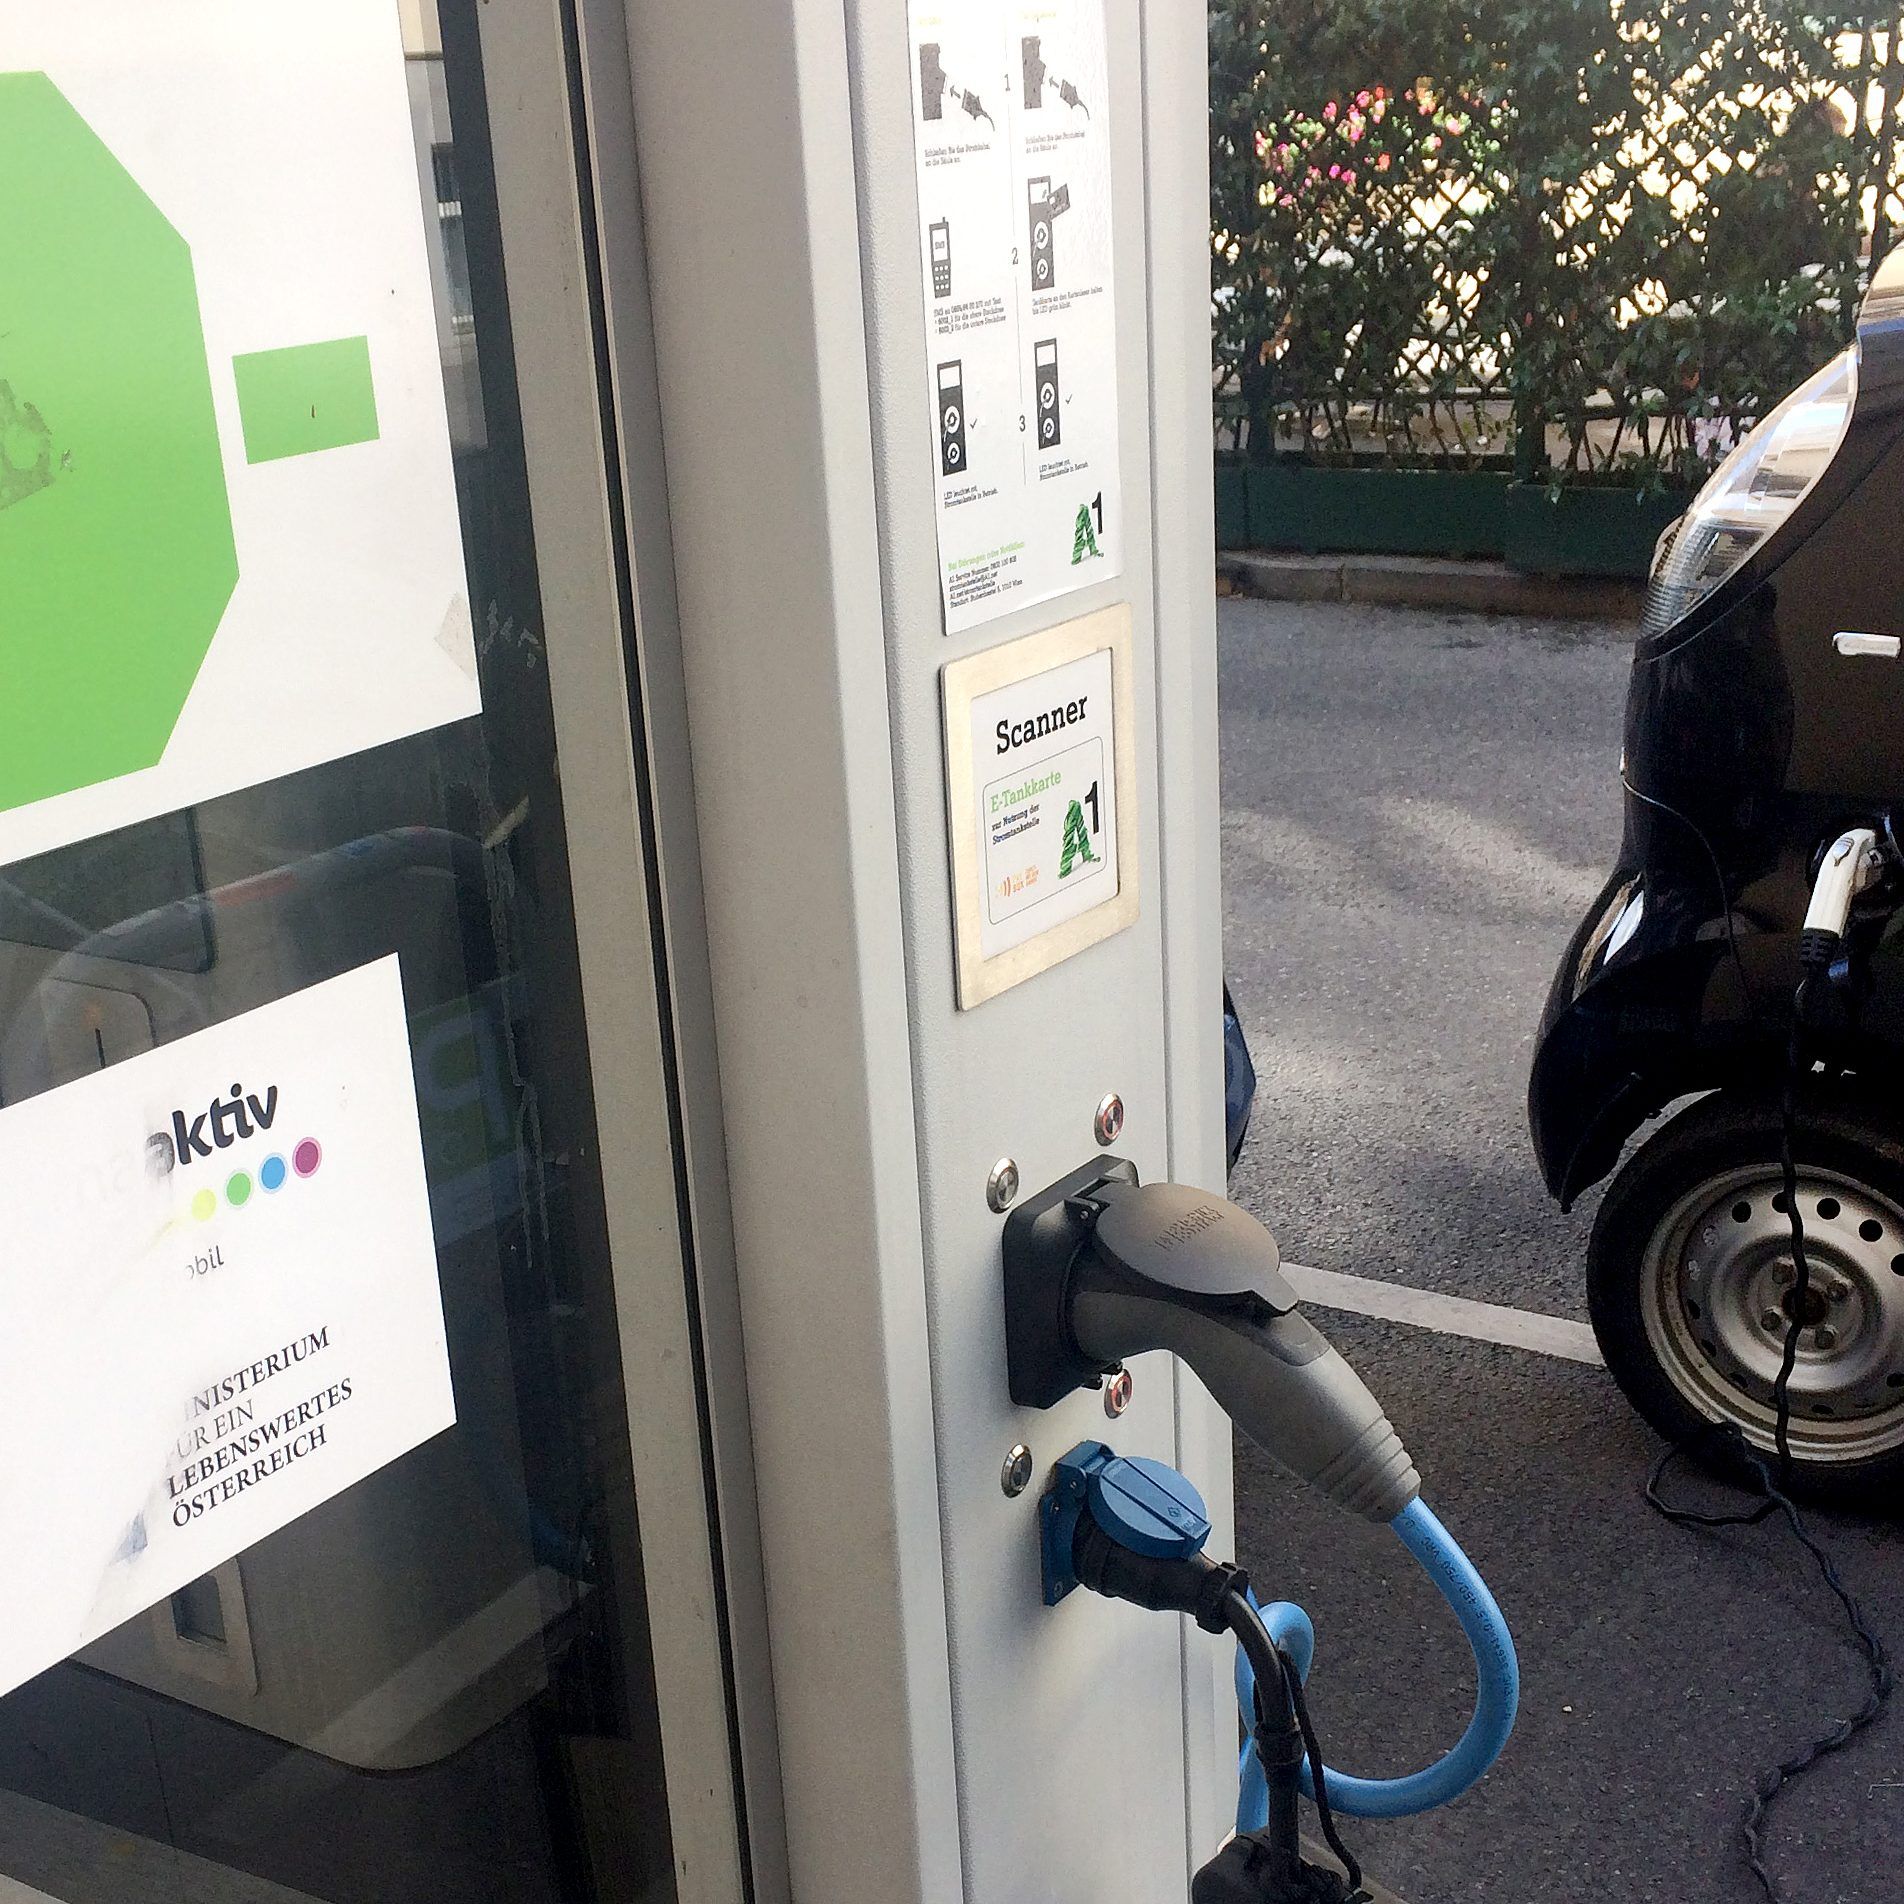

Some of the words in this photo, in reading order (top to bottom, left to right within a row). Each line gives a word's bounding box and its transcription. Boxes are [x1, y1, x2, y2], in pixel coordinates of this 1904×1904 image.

[1012, 247, 1018, 265] 2
[1019, 415, 1026, 432] 3
[1071, 491, 1103, 565] A1
[996, 696, 1088, 755] Scanner
[990, 770, 1062, 813] E-Tankkarte
[1058, 780, 1100, 879] A1
[146, 1083, 278, 1175] aktiv
[186, 1325, 330, 1420] NISTERIUM
[167, 1377, 353, 1499] LEBENSWERTES
[213, 1399, 254, 1439] EIN
[172, 1424, 328, 1527] ÖSTERREICH
